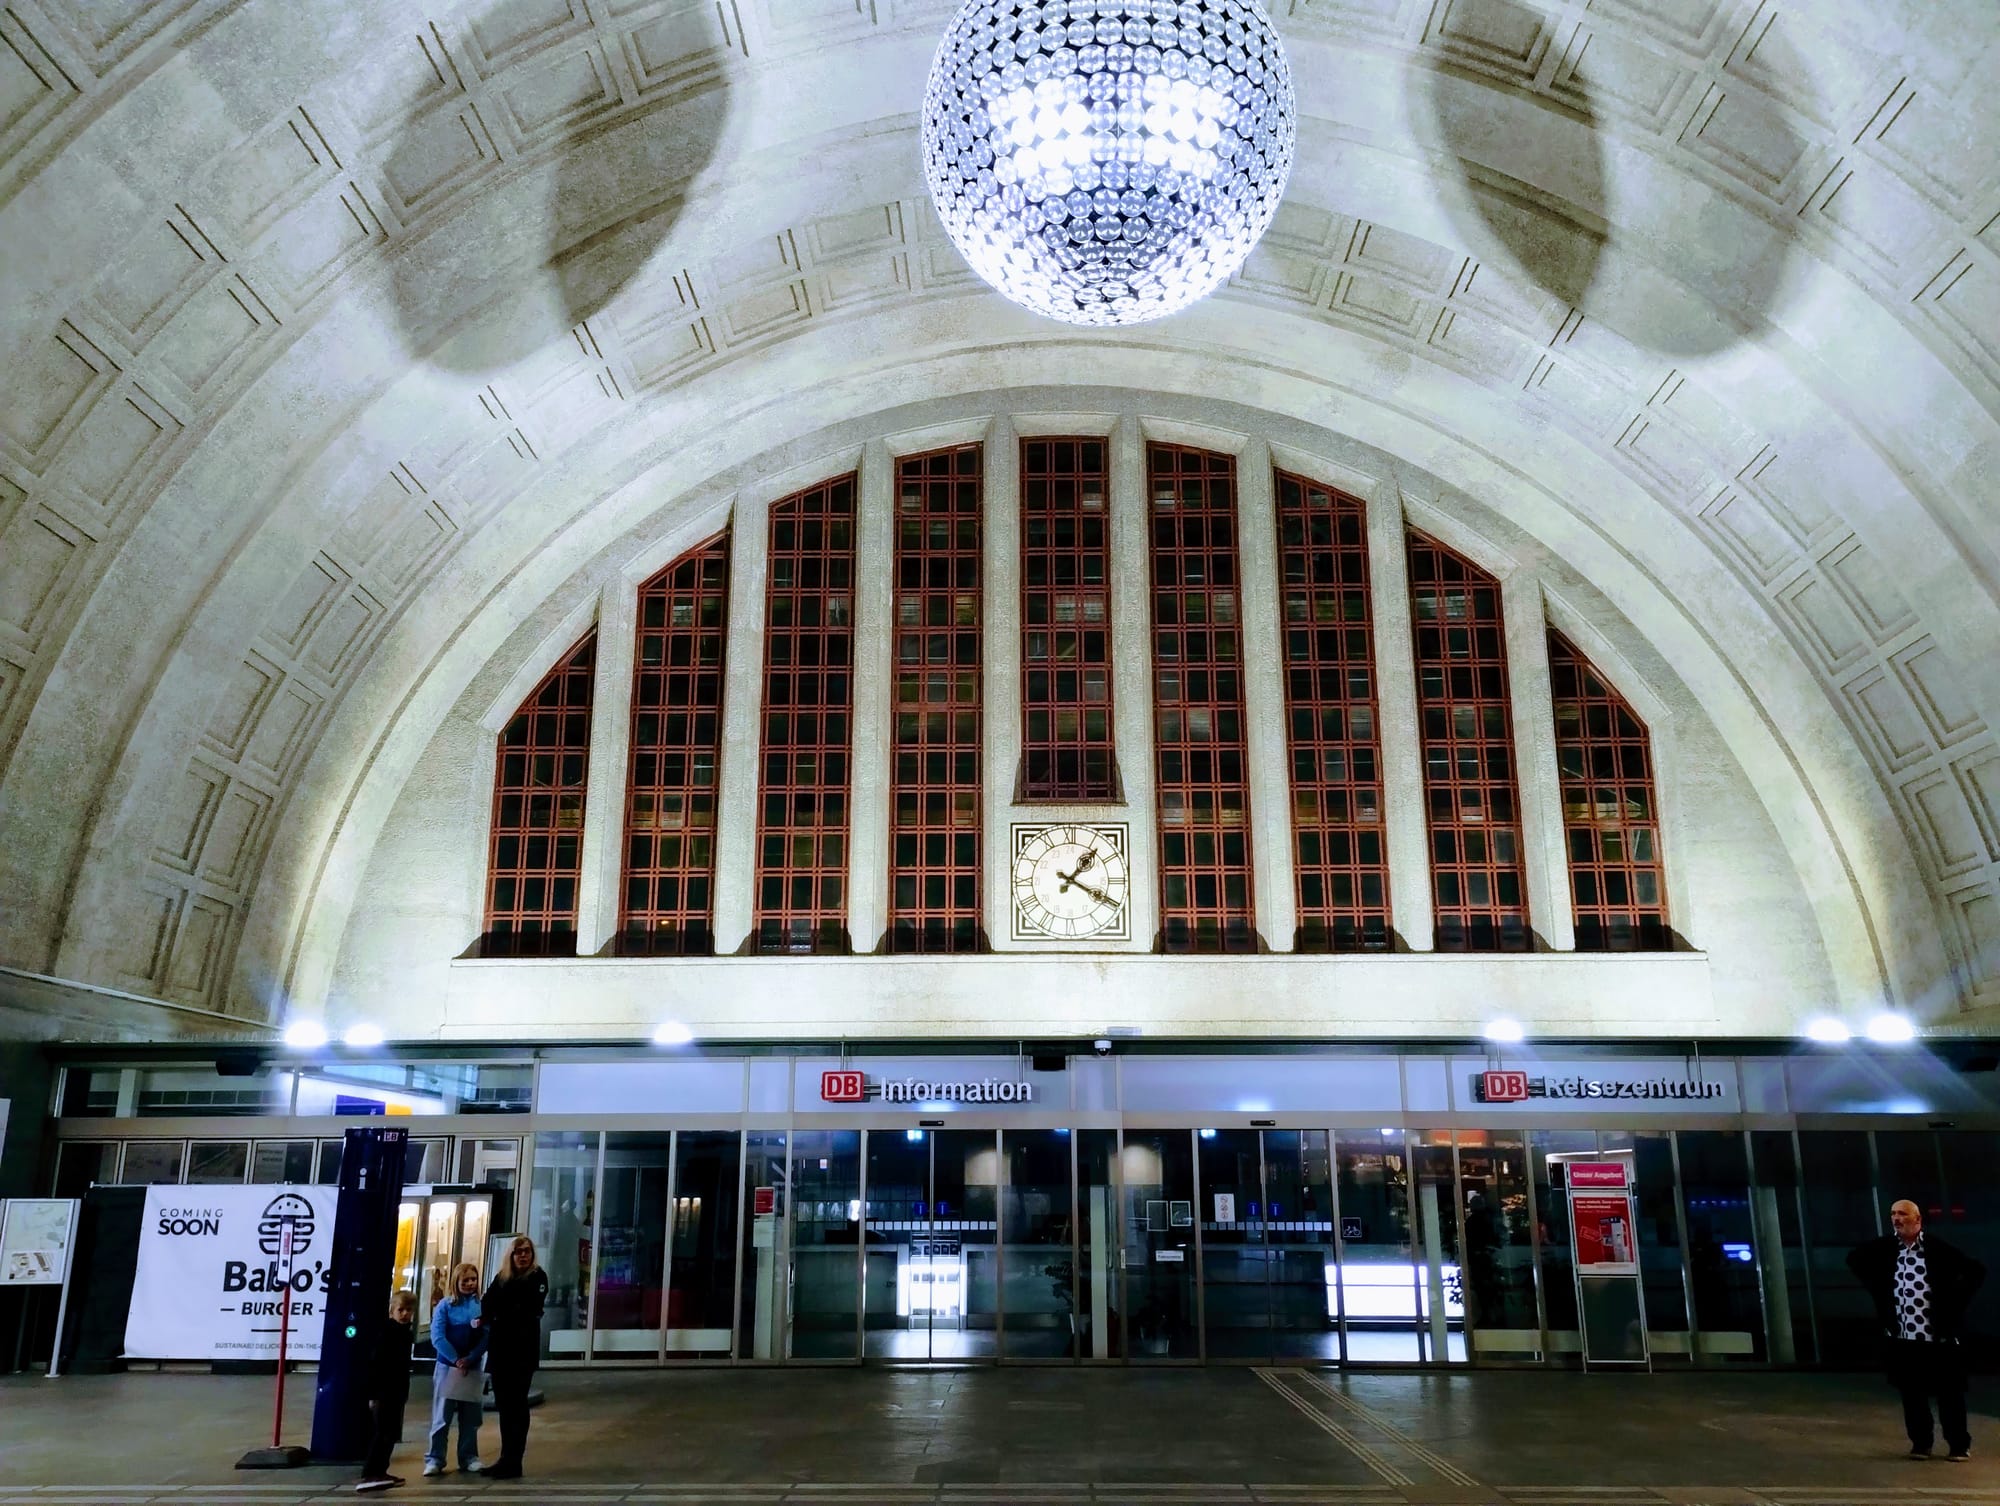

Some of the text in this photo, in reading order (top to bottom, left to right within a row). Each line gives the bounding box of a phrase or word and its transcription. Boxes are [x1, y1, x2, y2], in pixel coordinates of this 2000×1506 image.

[1063, 826, 1077, 844] XII
[825, 1074, 1032, 1102] DB Information
[1488, 1074, 1726, 1099] DB Reisezentrum
[159, 1208, 224, 1218] COMING
[157, 1219, 220, 1236] SOON
